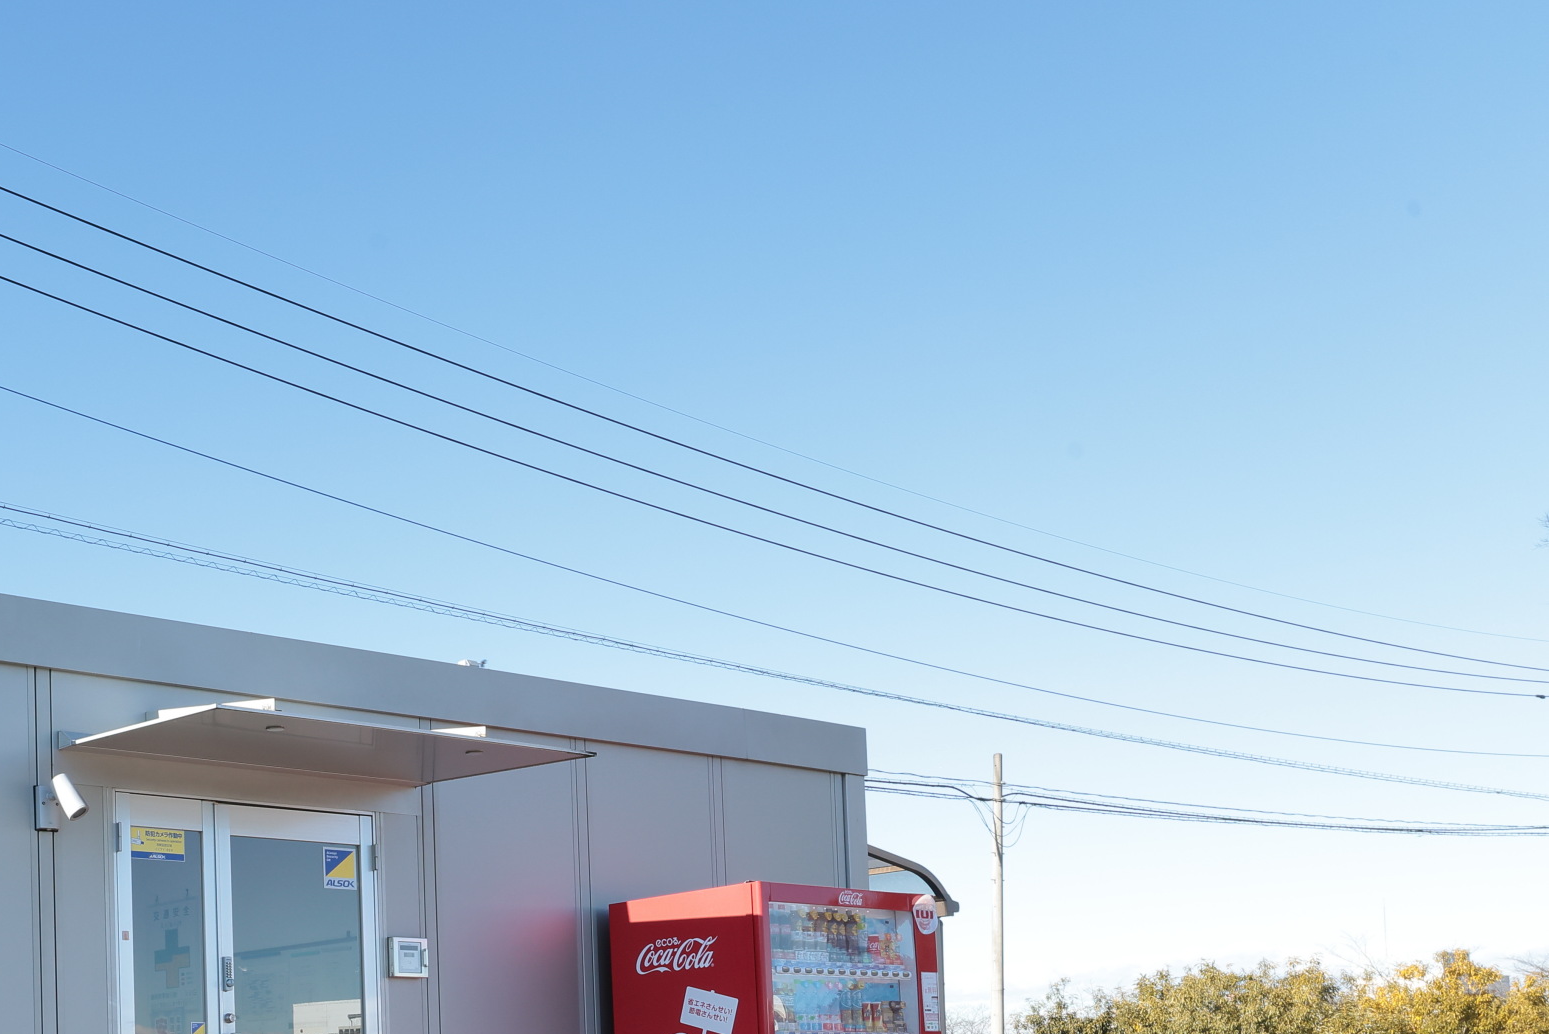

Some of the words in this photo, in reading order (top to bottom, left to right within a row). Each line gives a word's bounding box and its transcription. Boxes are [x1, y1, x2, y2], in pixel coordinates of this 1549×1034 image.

[145, 830, 183, 839] 防犯カメラ作動中
[326, 879, 355, 888] ALSOK
[635, 935, 719, 975] Coca-Cola
[687, 998, 733, 1016] 省エネさんせい!
[688, 1007, 729, 1023] 節電さんせい!
